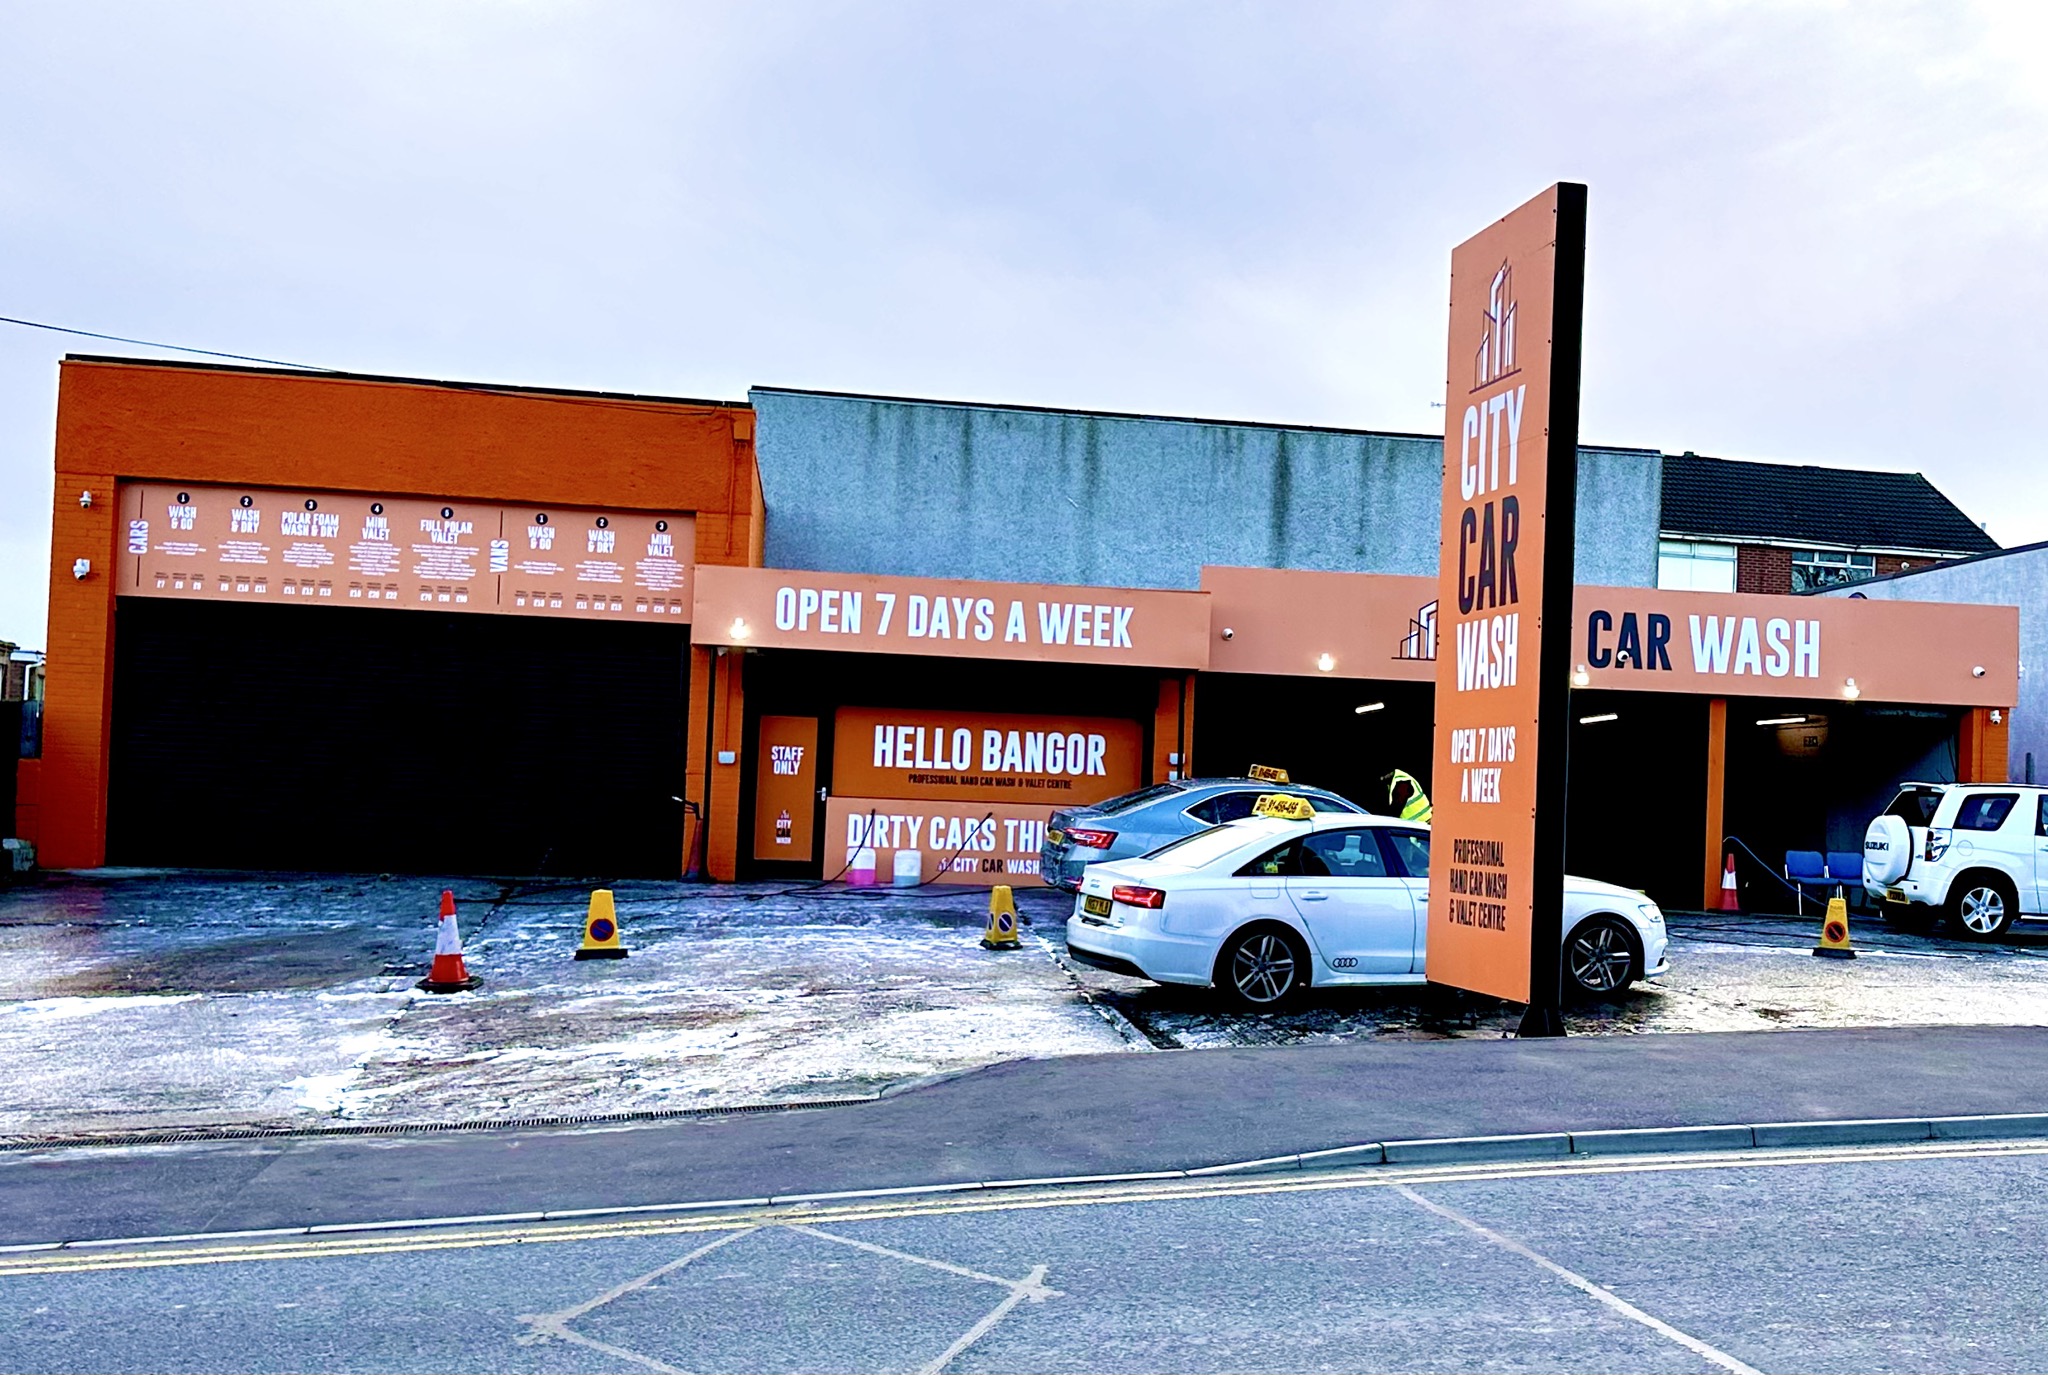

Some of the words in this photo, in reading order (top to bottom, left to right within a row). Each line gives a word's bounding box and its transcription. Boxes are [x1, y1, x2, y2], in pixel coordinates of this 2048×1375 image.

[1460, 384, 1526, 502] CITY
[168, 505, 197, 519] WASH
[231, 508, 260, 522] WASH
[282, 511, 311, 525] POLAR
[313, 513, 340, 526] FOAM
[171, 518, 179, 530] &
[180, 518, 193, 530] GO
[231, 520, 239, 533] &
[240, 521, 260, 534] DRY
[366, 516, 388, 529] MINI
[420, 519, 442, 532] FULL
[444, 520, 473, 534] POLAR
[128, 520, 149, 554] CARS
[281, 523, 309, 536] WASH
[311, 525, 319, 537] &
[320, 525, 340, 538] DRY
[362, 527, 391, 541] VALET
[430, 531, 459, 544] VALET
[527, 526, 555, 540] WASH
[588, 529, 616, 542] WASH
[538, 538, 551, 550] GO
[587, 541, 596, 553] &
[596, 541, 615, 554] DRY
[651, 533, 672, 547] MINI
[489, 539, 510, 573] VANS
[647, 544, 674, 557] VALET
[1458, 495, 1519, 615] CAR
[775, 586, 863, 634] OPEN
[875, 592, 896, 636] 7
[907, 594, 995, 641] DAYS
[1004, 600, 1027, 643] A
[1038, 602, 1135, 649] WEEK
[1587, 610, 1673, 671] CAR
[1688, 614, 1820, 678] WASH
[1456, 612, 1519, 692] WASH
[873, 724, 972, 771] HELLO
[982, 729, 1107, 776] BANGOR
[1451, 728, 1476, 764] OPEN
[1478, 727, 1486, 763] 7
[1487, 726, 1516, 763] DAYS
[771, 745, 804, 761] STAFF
[773, 760, 801, 775] ONLY
[908, 774, 958, 785] PROFESSIONAL
[980, 777, 994, 787] CAR
[995, 777, 1016, 787] WASH
[1025, 778, 1045, 789] VALET
[1046, 779, 1072, 790] CENTRE
[1460, 768, 1468, 803] A
[1471, 768, 1502, 803] WEEK
[847, 813, 924, 849] DIRTY
[929, 816, 997, 852] CARS
[1004, 819, 1050, 853] THI
[1453, 838, 1505, 867] PROFESSIONAL
[1865, 841, 1889, 851] SUZUKI
[953, 857, 980, 873] CITY
[982, 858, 1003, 874] CAR
[1007, 859, 1040, 875] WASH
[1449, 868, 1468, 895] HAND
[1469, 869, 1483, 896] CAR
[1484, 872, 1507, 900] WASH
[1449, 898, 1455, 923] &
[1456, 899, 1478, 928] VALET
[1478, 902, 1506, 932] CENTRE
